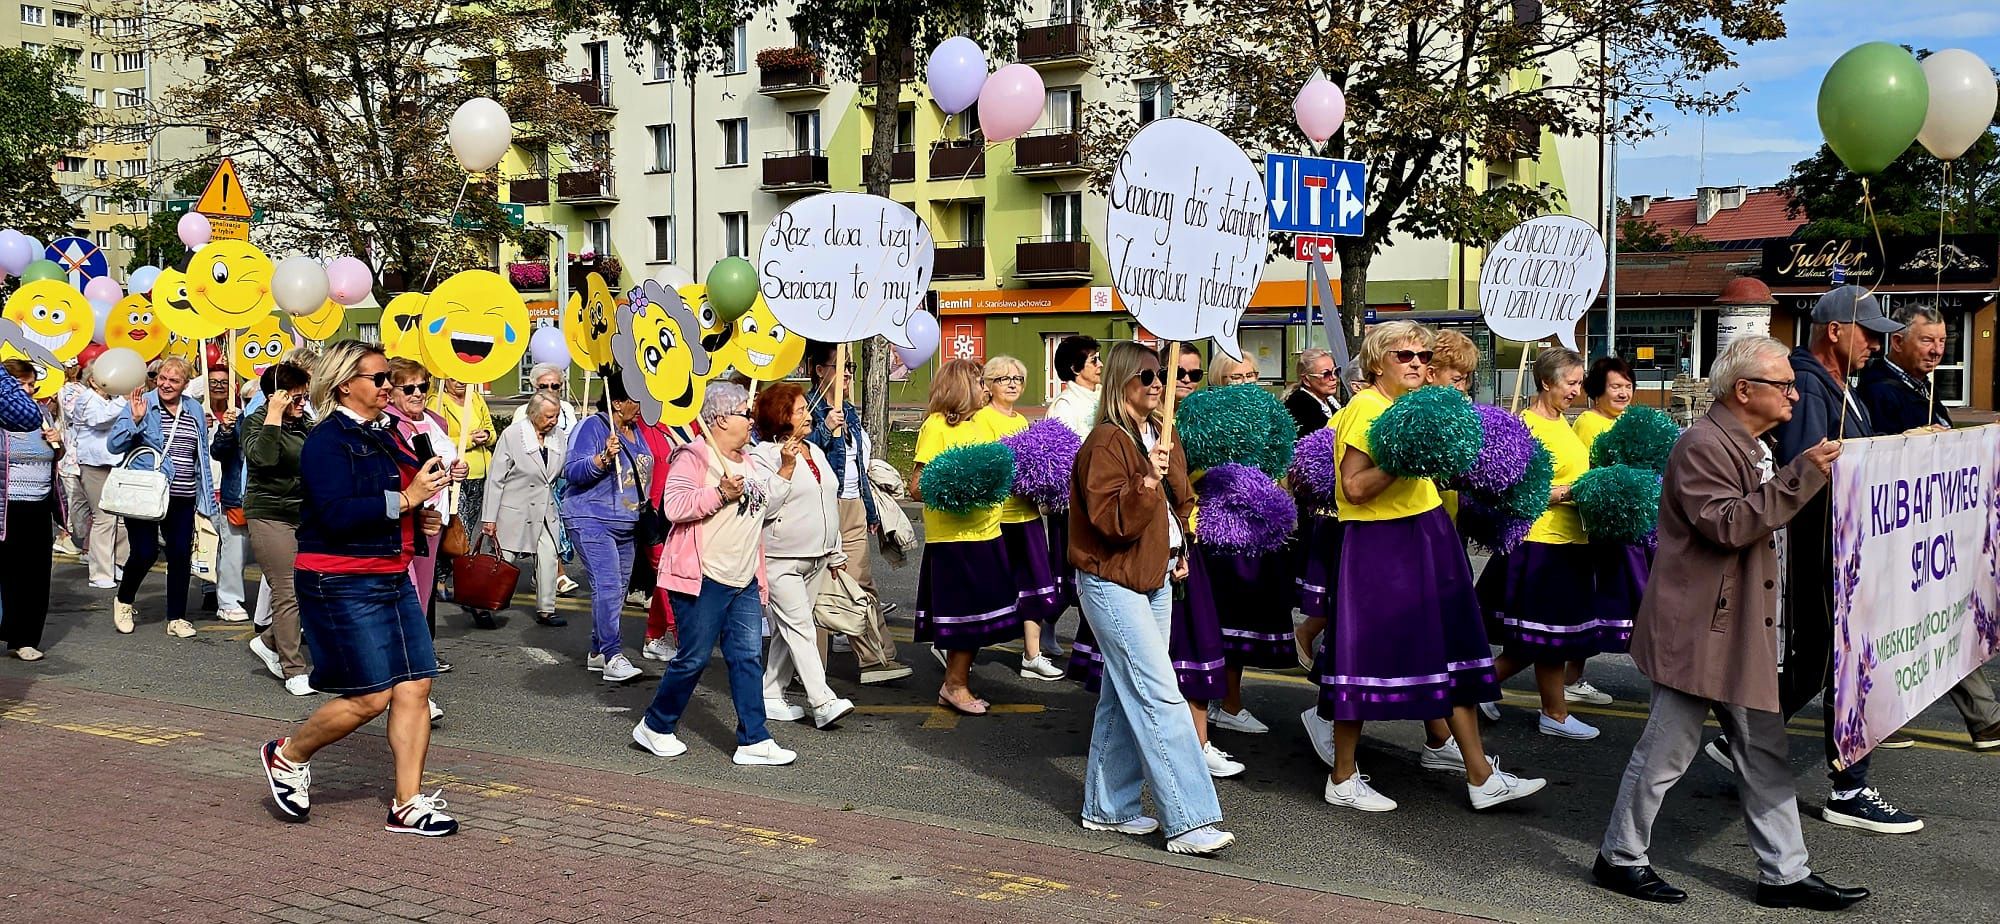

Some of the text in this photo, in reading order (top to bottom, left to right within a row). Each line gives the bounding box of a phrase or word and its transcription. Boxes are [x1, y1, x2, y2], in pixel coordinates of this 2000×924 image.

[1111, 150, 1175, 246] Seniorzy
[1184, 166, 1213, 227] dziś
[876, 208, 922, 267] trzy!
[1504, 223, 1565, 255] SENIORZY
[1777, 239, 1868, 275] Jubiler
[763, 260, 923, 326] Seniorzy to my!
[940, 298, 972, 308] Gemini
[1484, 289, 1499, 317] W
[1540, 291, 1551, 320] I
[530, 307, 548, 317] pteka
